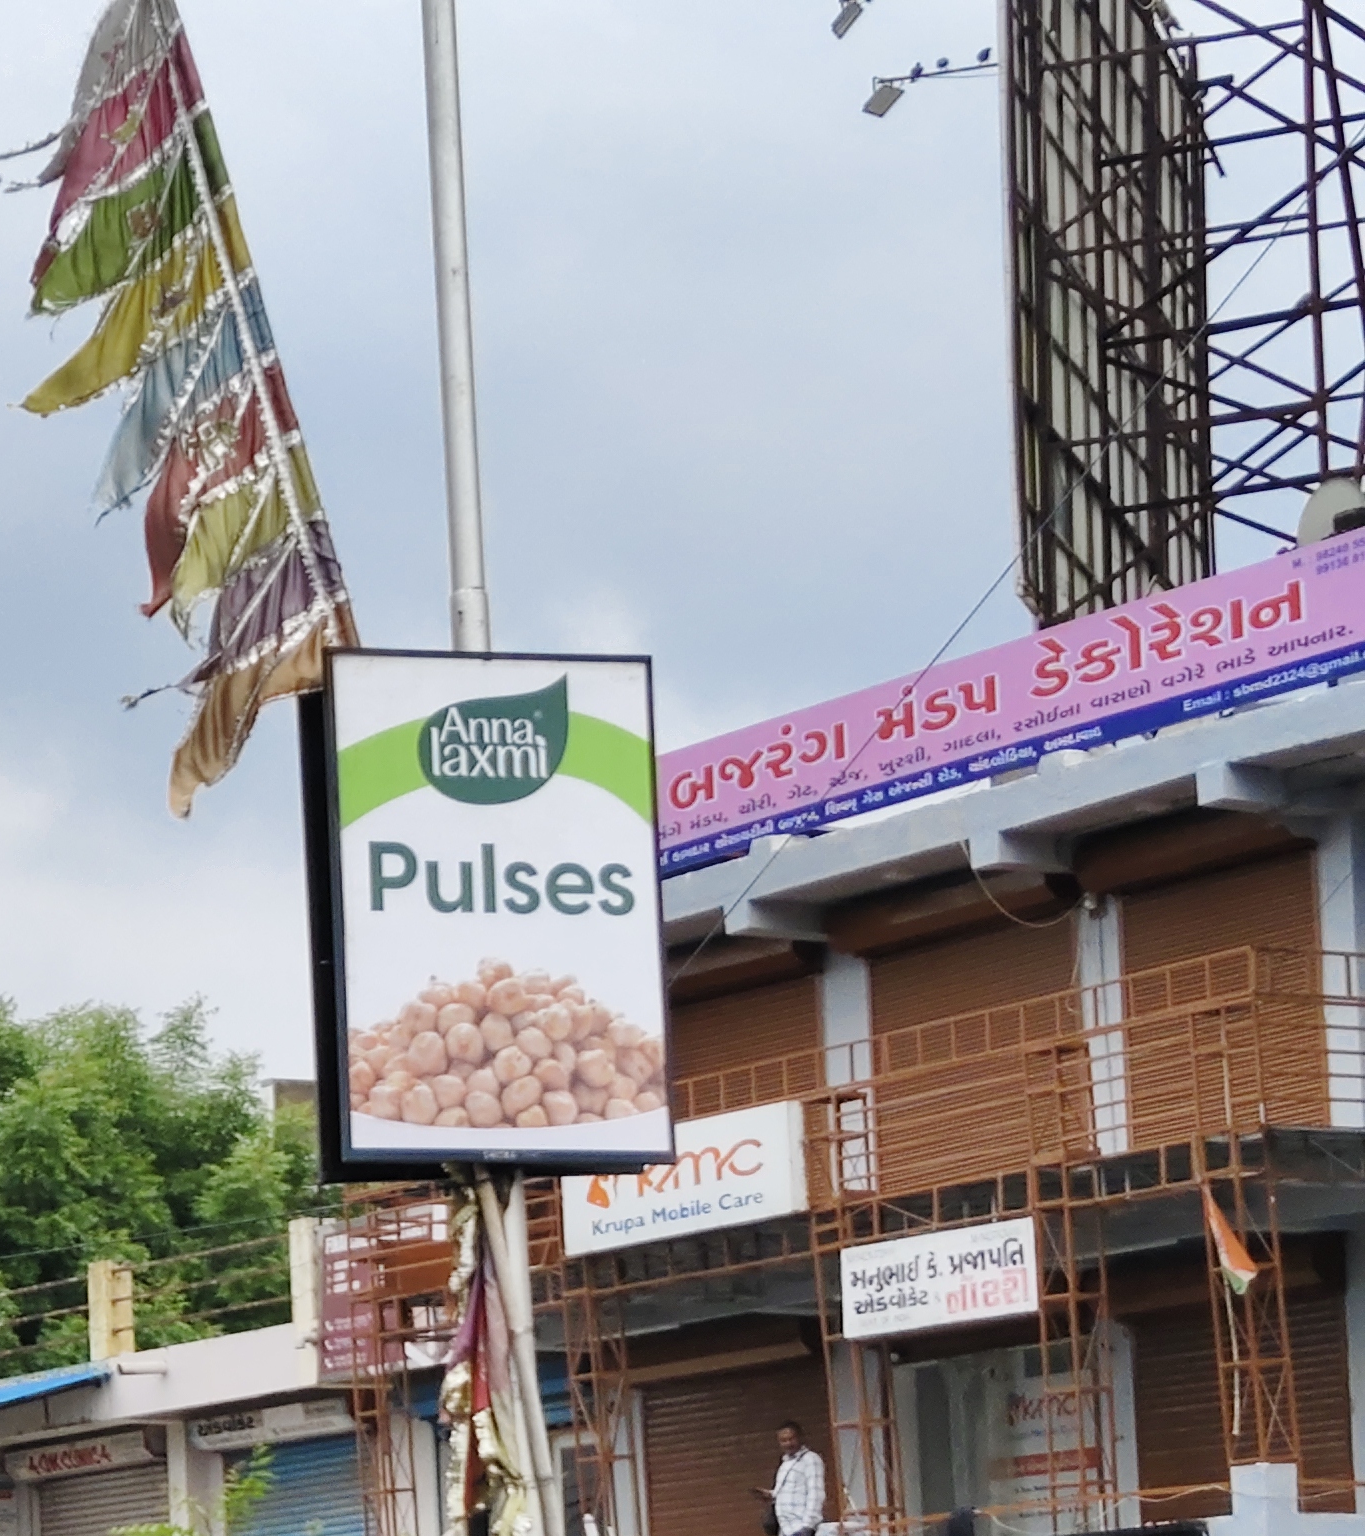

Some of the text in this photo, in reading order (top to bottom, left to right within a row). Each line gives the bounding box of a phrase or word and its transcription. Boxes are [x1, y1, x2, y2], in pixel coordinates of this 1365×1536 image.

[668, 578, 1303, 811] બજરંગ મંડપ ડેકોરેશન
[1182, 690, 1222, 712] Email
[429, 725, 550, 779] laxmi
[439, 706, 537, 744] Anna
[689, 813, 729, 830] મંડપ,
[787, 783, 818, 800] ગેટ,
[942, 729, 1002, 753] ગાદલા,
[1013, 703, 1081, 732] રસોઈના
[1090, 679, 1151, 709] વાસણો
[1161, 662, 1206, 688] વગેરે
[1217, 648, 1257, 674] ભાડે
[1267, 624, 1354, 657] આપનાર.
[368, 840, 636, 916] Pulses
[591, 1190, 764, 1236] Krupa Mobile Care
[850, 1254, 920, 1293] મનુભાઈ
[948, 1237, 1025, 1275] પ્રજાપતિ
[853, 1286, 929, 1315] એડવોકેટ
